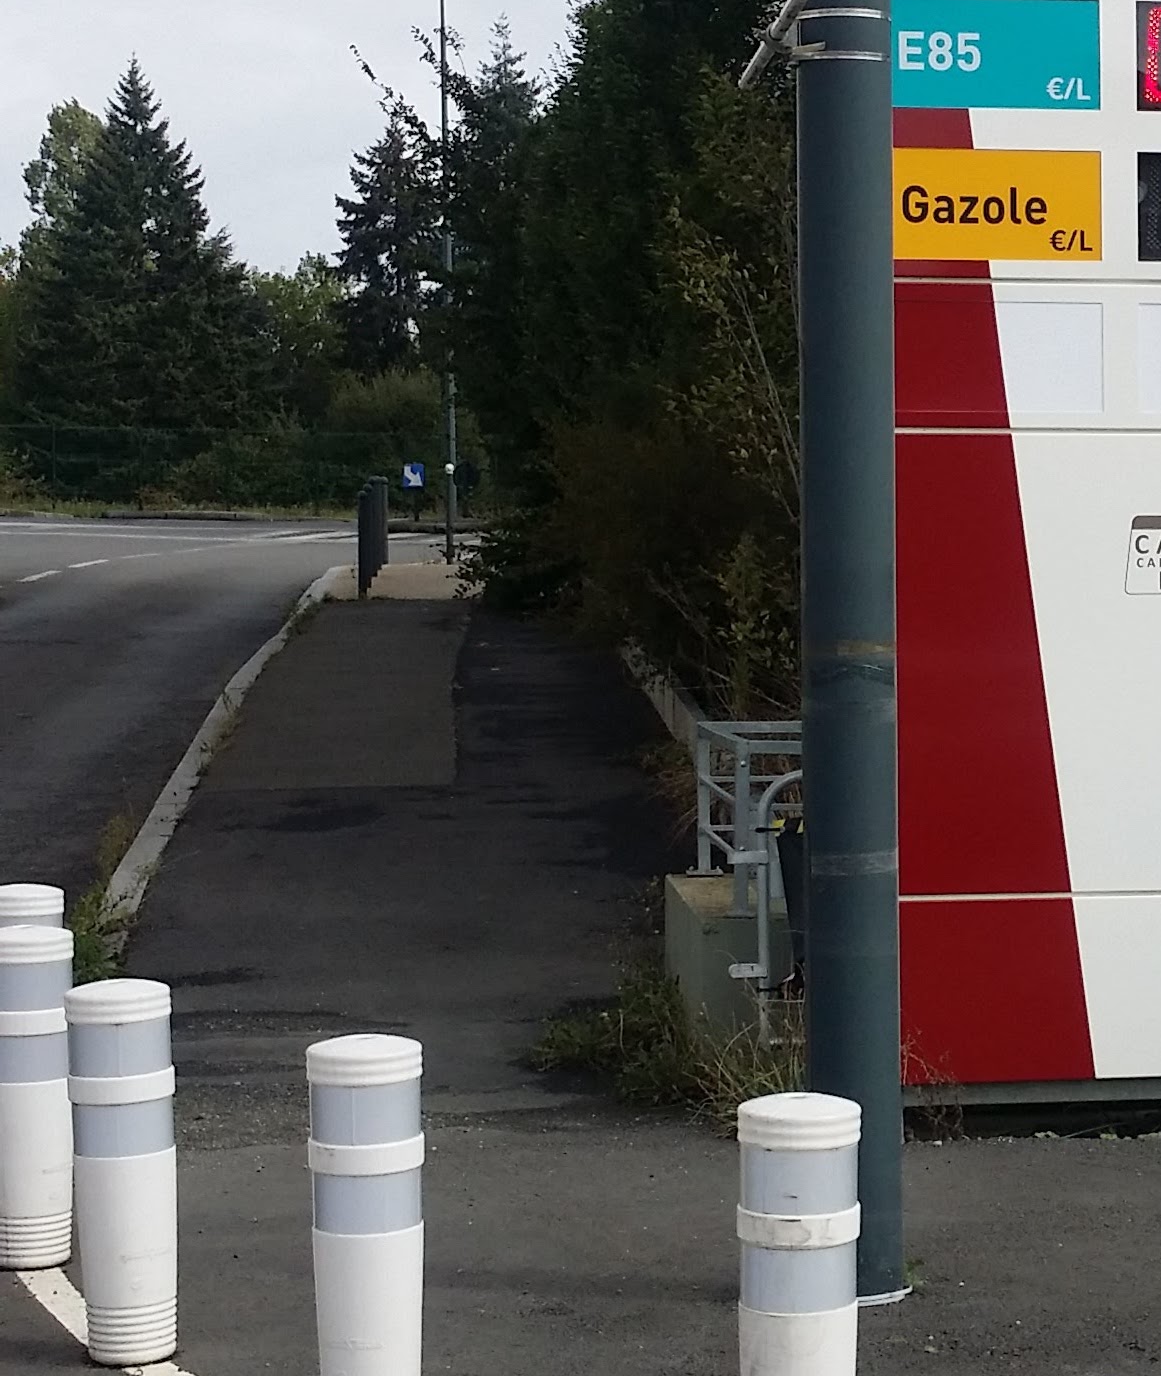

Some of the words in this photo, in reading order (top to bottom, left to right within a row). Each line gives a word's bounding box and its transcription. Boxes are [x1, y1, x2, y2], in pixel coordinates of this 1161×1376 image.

[898, 30, 981, 72] E85
[1046, 77, 1091, 101] €/L
[901, 184, 1048, 225] Gazole
[1049, 229, 1093, 252] €/L
